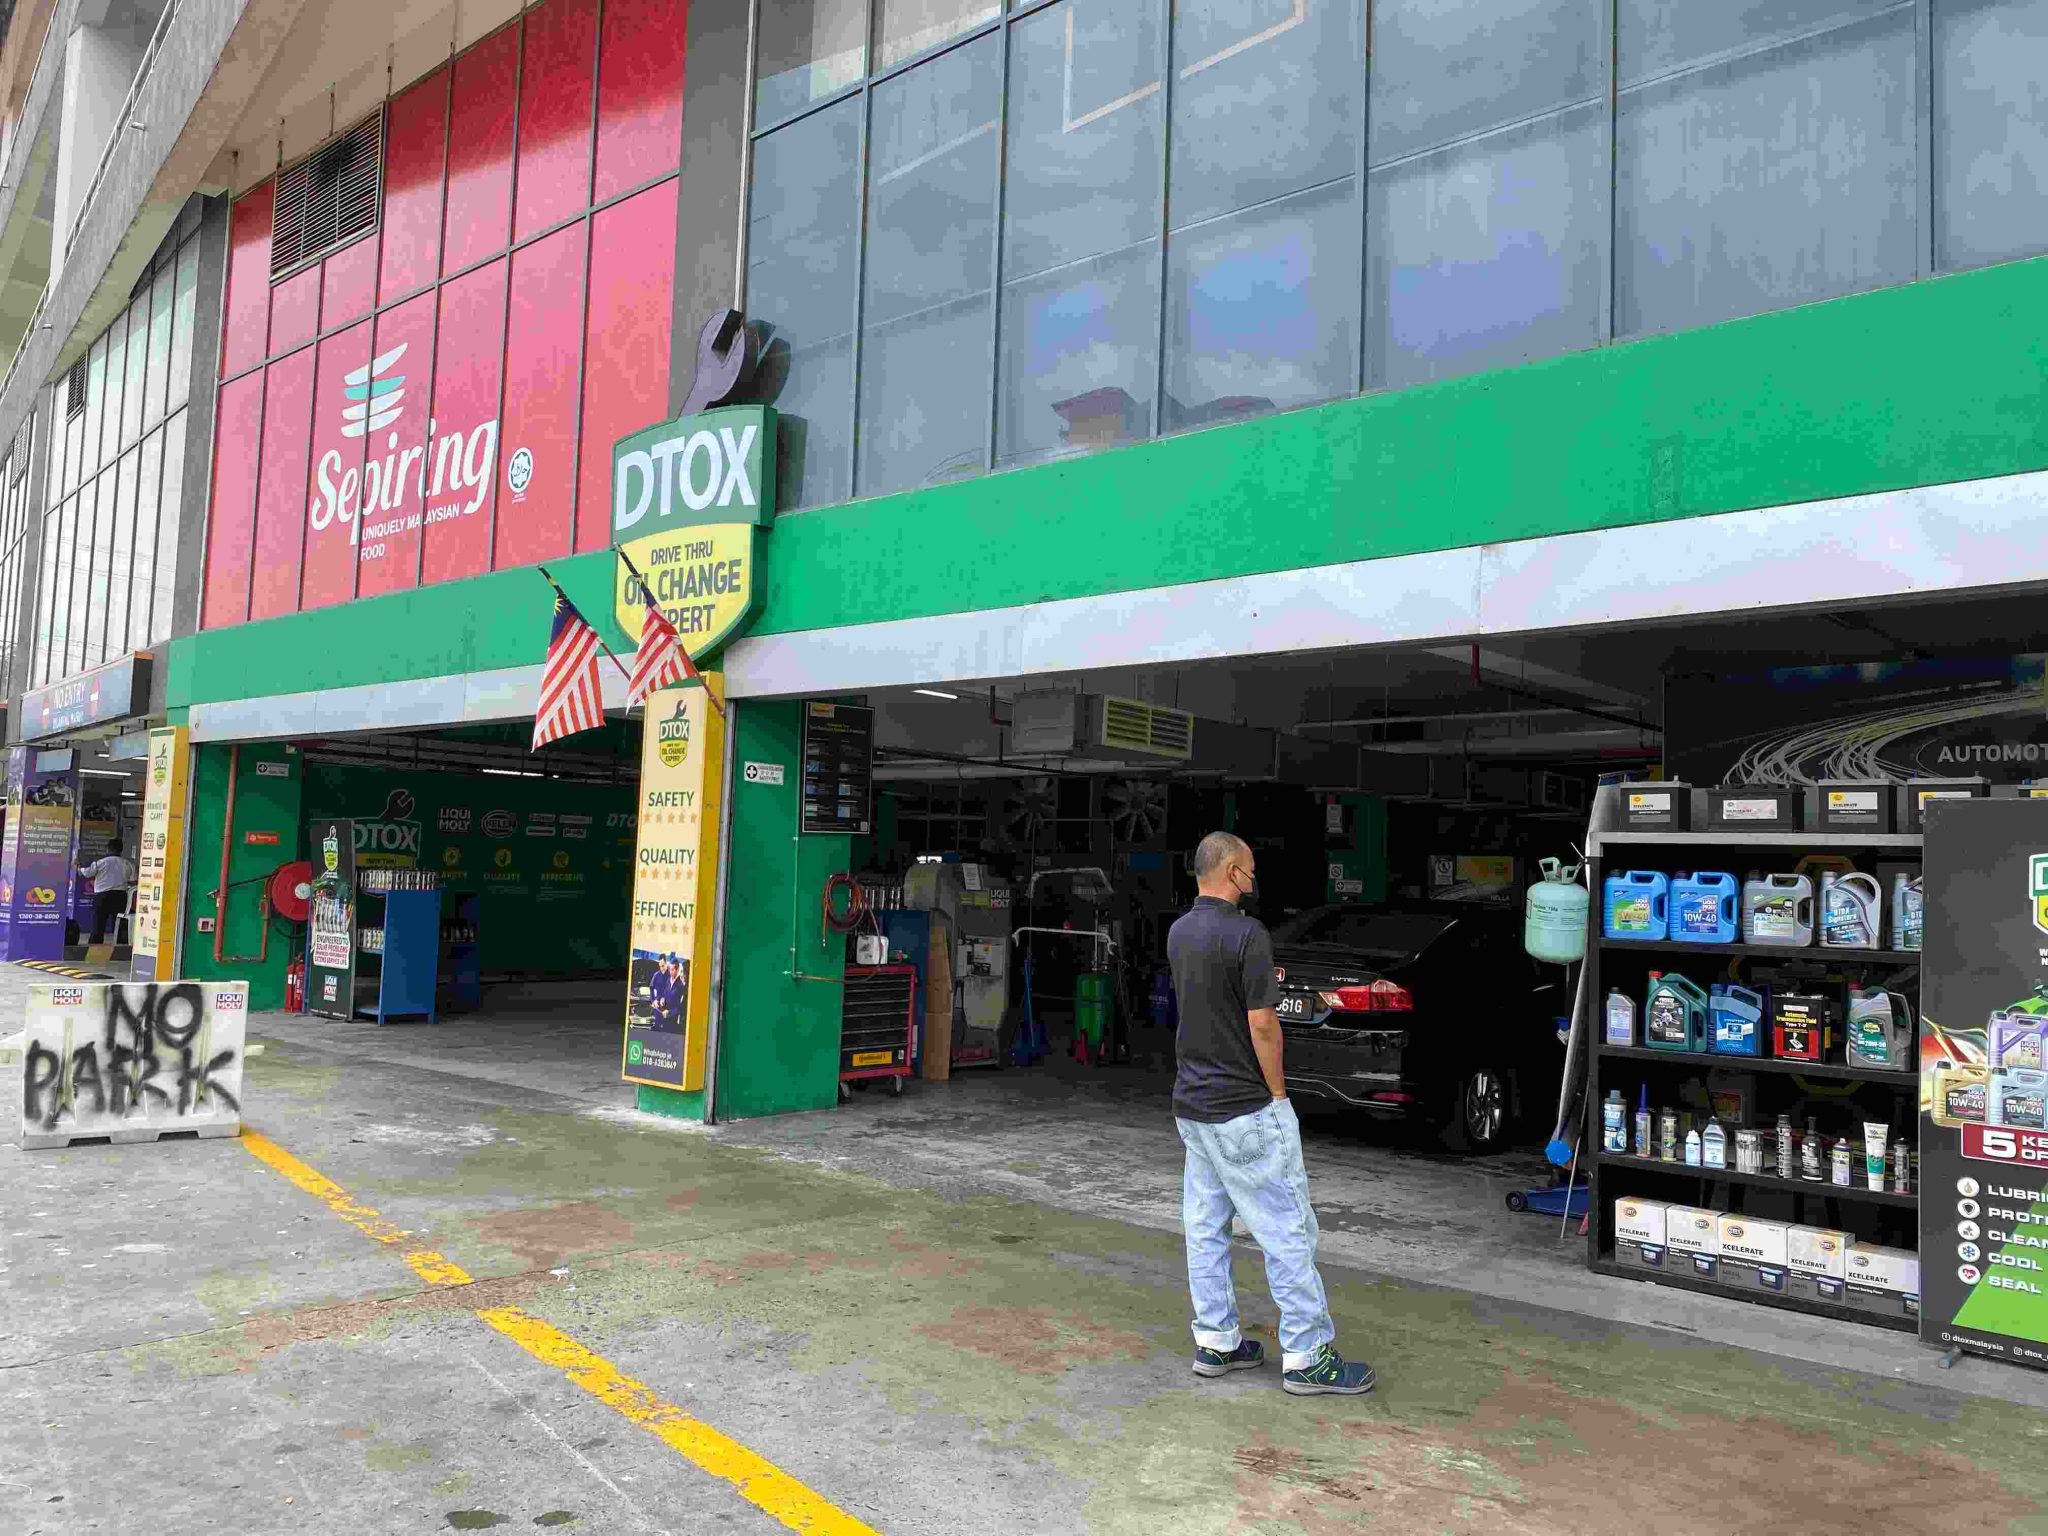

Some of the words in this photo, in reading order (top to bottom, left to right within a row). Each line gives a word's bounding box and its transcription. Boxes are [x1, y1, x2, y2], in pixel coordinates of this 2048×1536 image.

[311, 418, 498, 545] Sepiring
[615, 425, 758, 531] DTOX
[362, 518, 406, 541] UNIQUELY
[407, 503, 460, 530] MAAYSIAN
[360, 543, 385, 561] FOOD
[651, 545, 681, 566] DRIVE
[685, 540, 713, 560] THRU
[658, 559, 742, 601] CHANGE
[663, 604, 715, 634] PERT
[660, 721, 689, 739] DTOX
[1938, 744, 2048, 764] AUTOMOT
[648, 791, 695, 807] SAFETY
[440, 808, 470, 819] LIQUI
[439, 819, 470, 831] MOLY
[354, 823, 417, 852] DTOX
[640, 848, 695, 865] QUALITY
[635, 900, 694, 919] EFFICIENT
[1684, 913, 1717, 923] 10W-40
[53, 996, 82, 1004] MOLY
[54, 989, 83, 997] LIQUI
[216, 994, 243, 1002] LIQUI
[216, 1001, 242, 1009] MOLY
[105, 984, 203, 1050] NO
[24, 1039, 240, 1130] PARK
[1948, 1097, 1984, 1109] 10W-40
[2006, 1104, 2042, 1115] 10W-40
[1983, 1130, 2016, 1158] 5
[1988, 1184, 2048, 1203] LUBRI
[1988, 1207, 2048, 1226] PROT
[1619, 1227, 1650, 1238] XCELERATE
[1669, 1237, 1702, 1247] XCELERATE
[1722, 1243, 1764, 1256] XCELERATE
[1790, 1258, 1827, 1270] XCELERATE
[1988, 1252, 2043, 1271] COOL
[1848, 1271, 1888, 1284] XCELERATE
[1988, 1275, 2042, 1294] SEAL
[1952, 1335, 2004, 1351] dtoxmalaysia
[2024, 1349, 2048, 1362] dtox_
